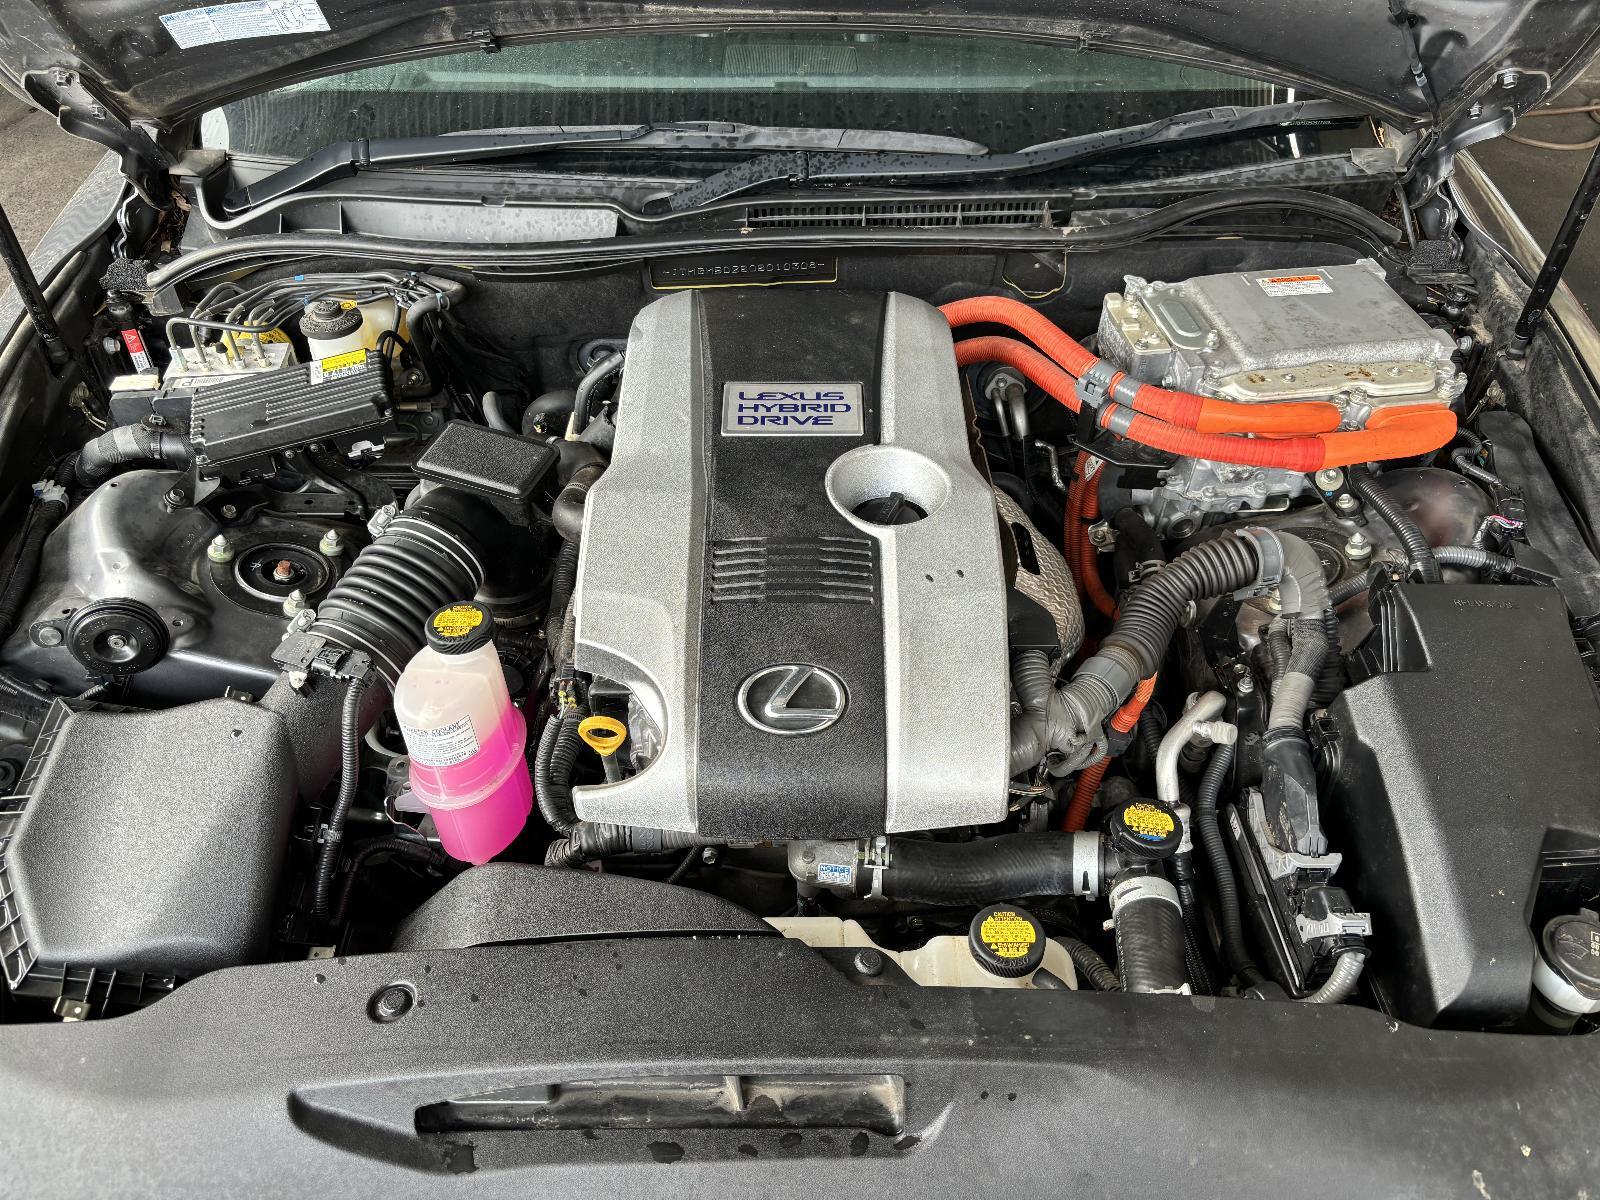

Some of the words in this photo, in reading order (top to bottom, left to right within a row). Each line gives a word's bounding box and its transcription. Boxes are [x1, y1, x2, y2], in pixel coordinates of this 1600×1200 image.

[738, 392, 845, 401] LEXUS
[737, 403, 852, 413] HYBRID
[737, 415, 834, 426] DRIVE
[820, 865, 849, 874] NOTICE
[994, 956, 1029, 967] DENSO
